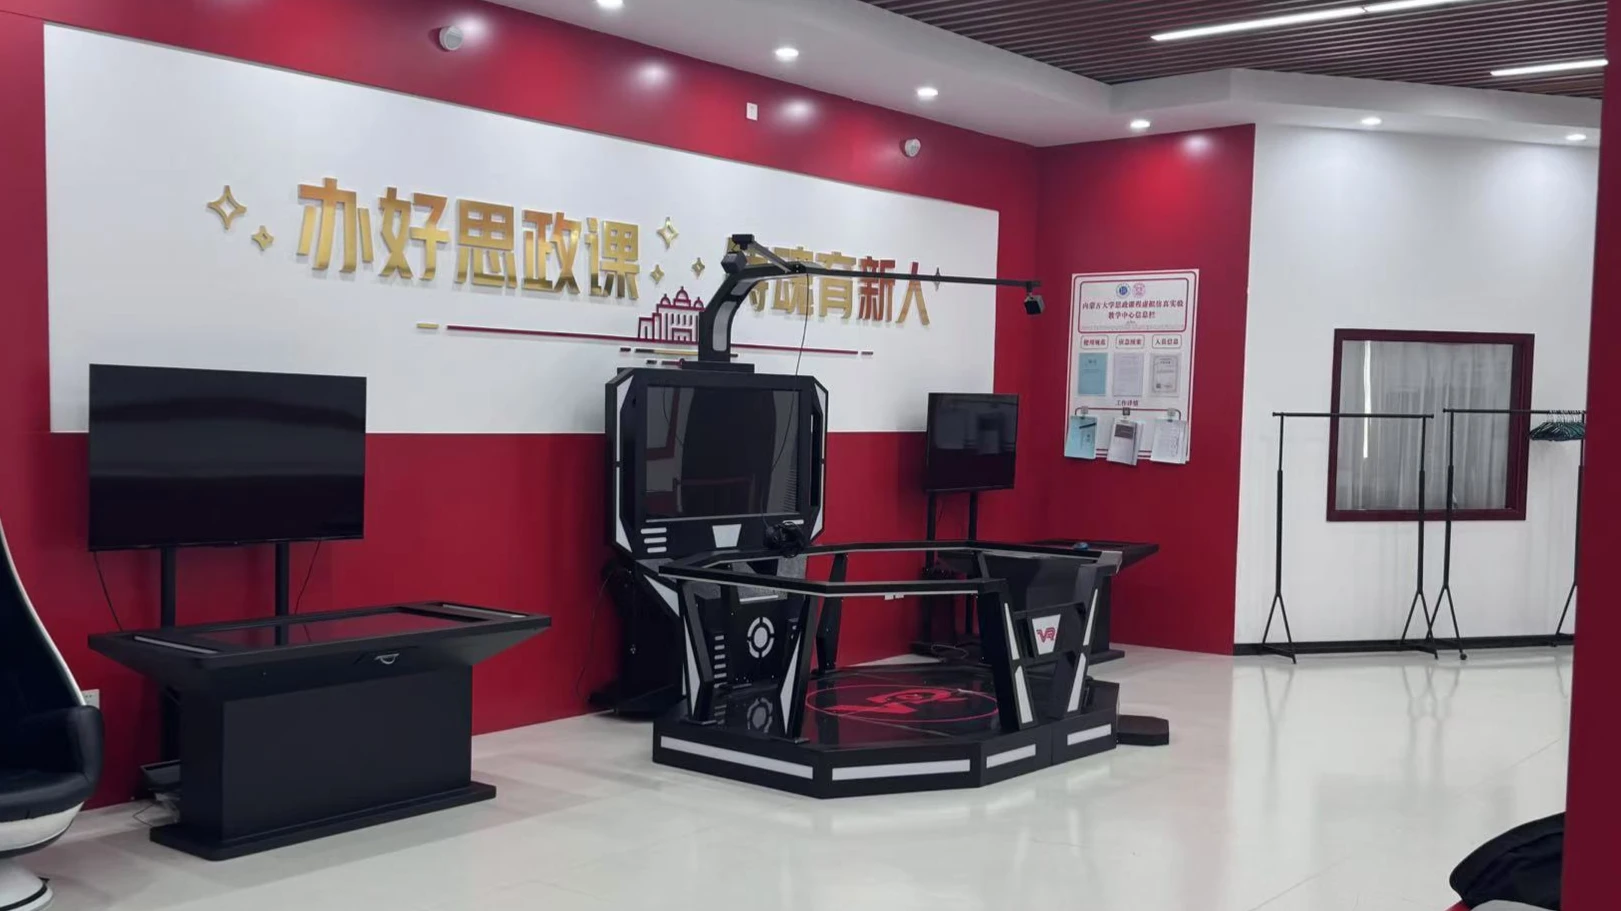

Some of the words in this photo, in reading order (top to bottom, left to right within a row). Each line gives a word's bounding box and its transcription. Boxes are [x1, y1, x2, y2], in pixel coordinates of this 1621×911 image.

[296, 177, 640, 299] 办好思政课
[1036, 626, 1056, 643] VR
